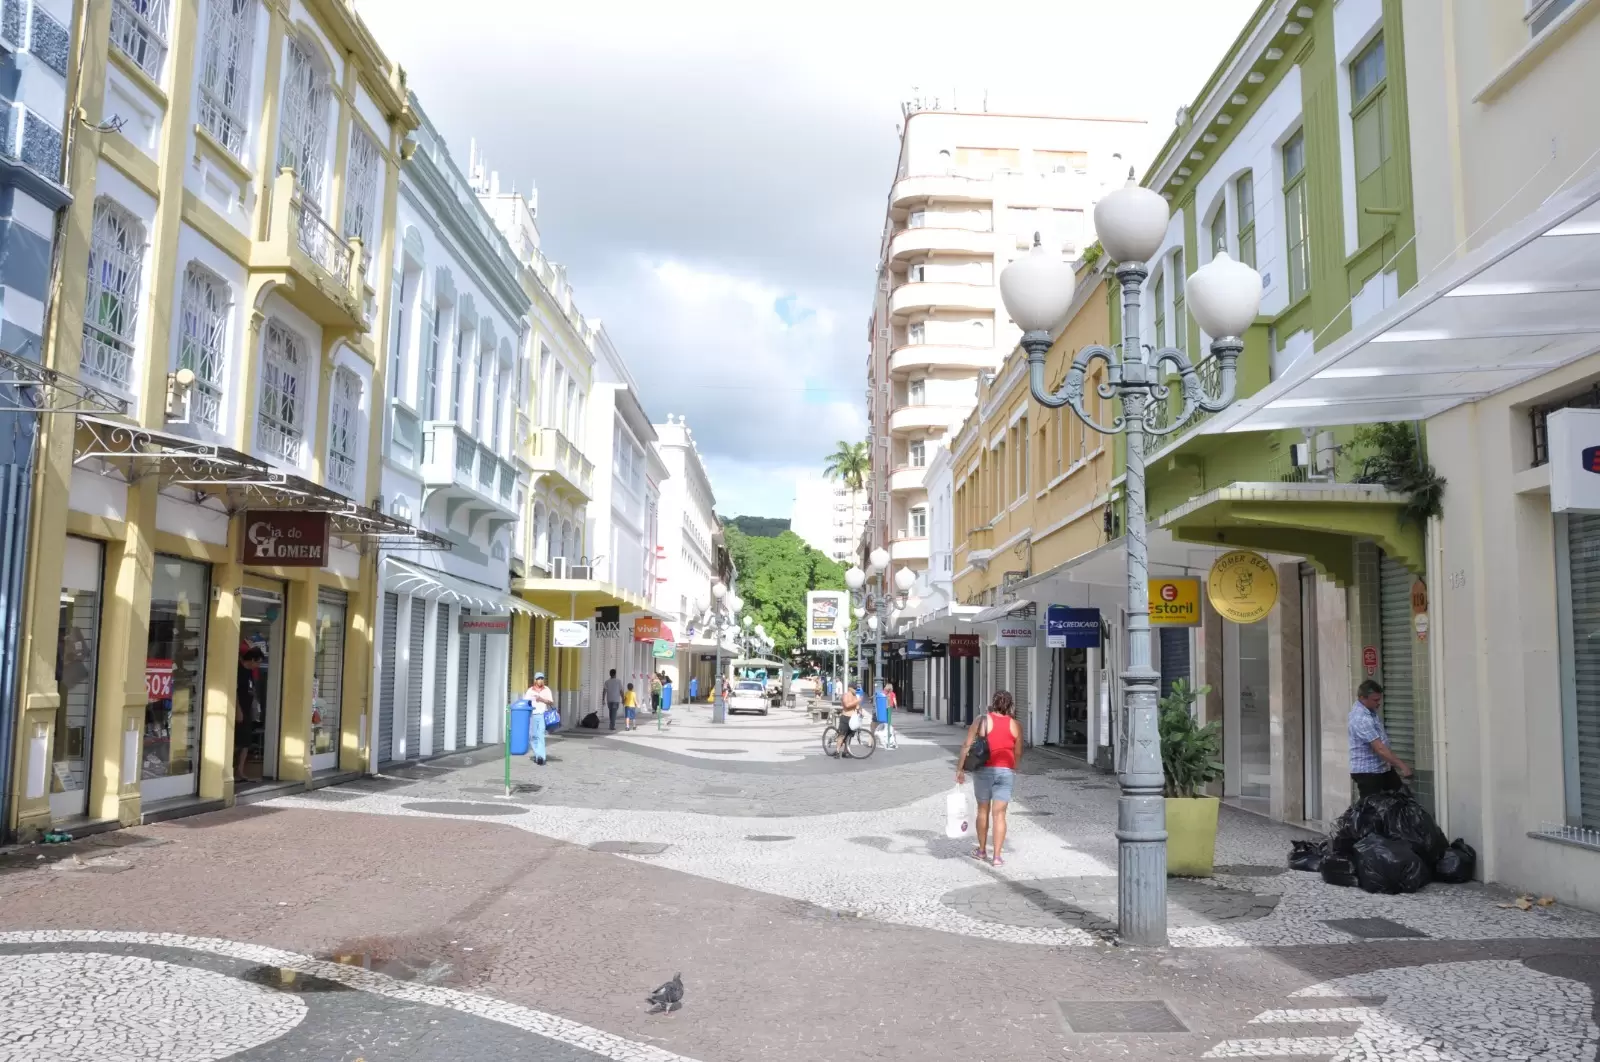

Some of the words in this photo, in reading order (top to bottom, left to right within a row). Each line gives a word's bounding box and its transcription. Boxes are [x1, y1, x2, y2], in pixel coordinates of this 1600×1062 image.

[287, 527, 302, 539] do
[1217, 554, 1247, 573] COMER
[1250, 556, 1268, 572] BEM
[637, 624, 660, 634] vivo
